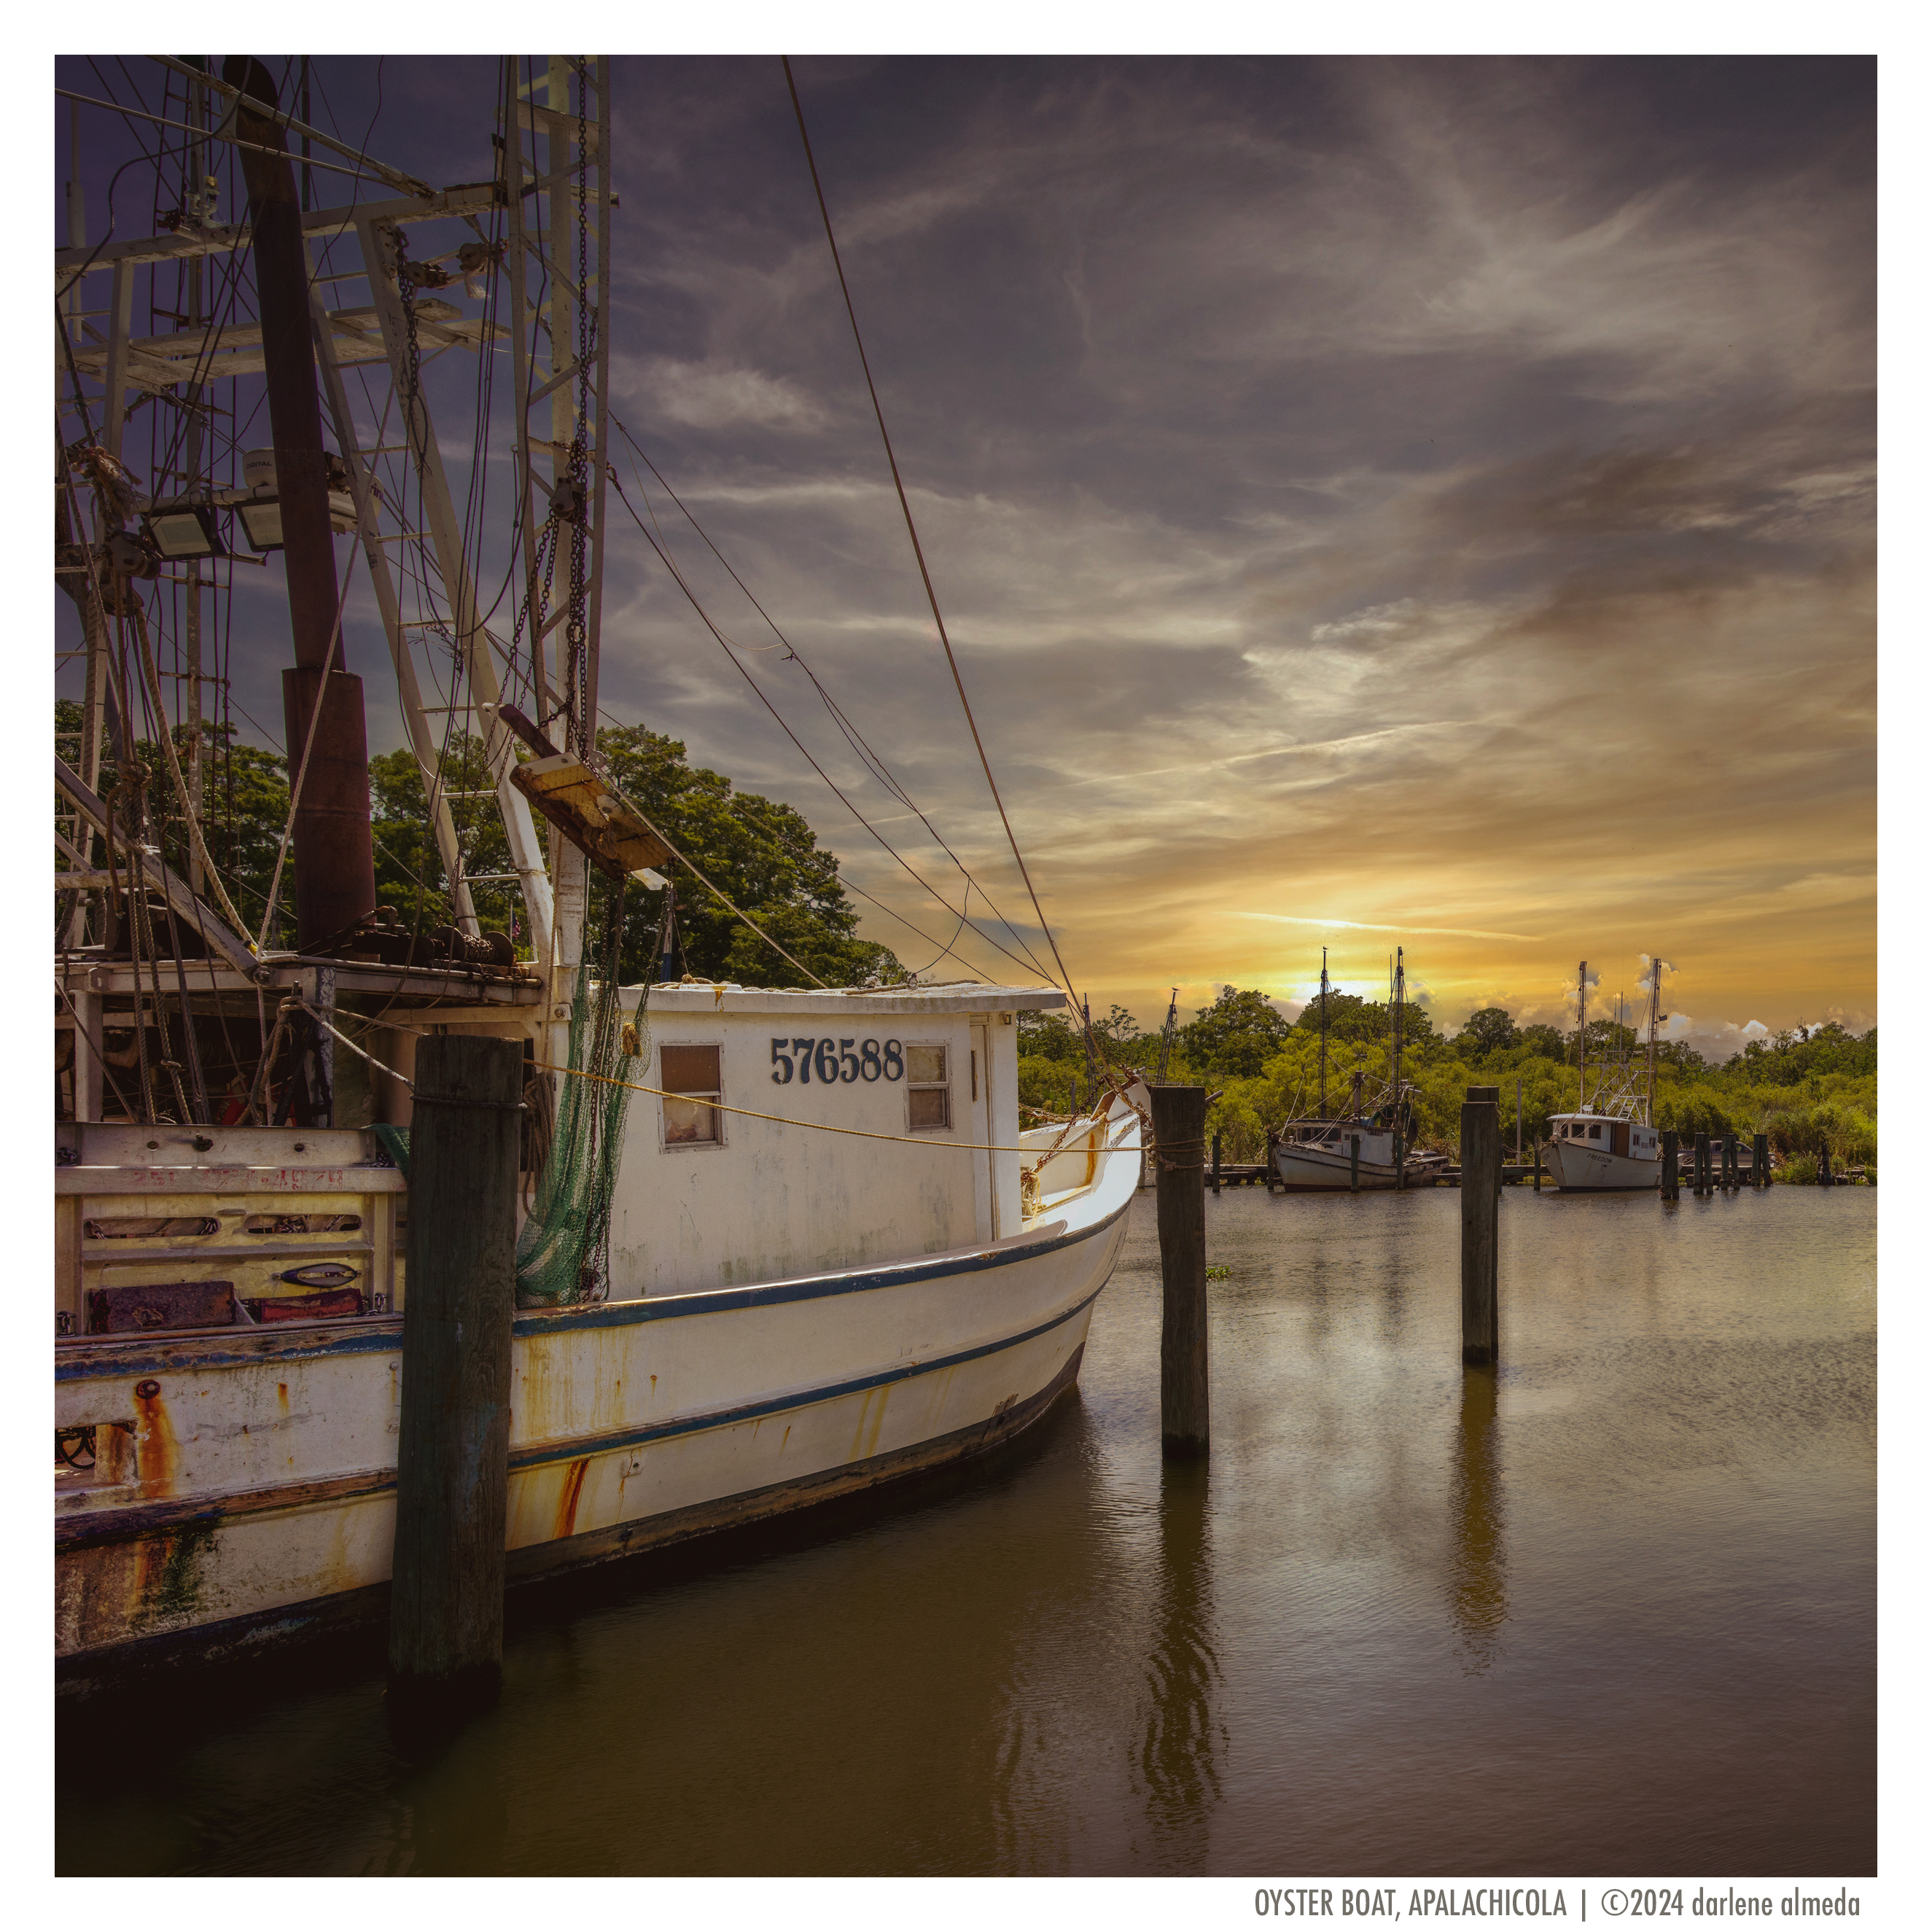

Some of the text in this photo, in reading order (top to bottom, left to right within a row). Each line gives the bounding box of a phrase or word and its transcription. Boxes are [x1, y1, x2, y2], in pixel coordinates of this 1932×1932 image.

[771, 1037, 904, 1085] 576588
[1587, 1153, 1613, 1164] FREEDOM
[133, 1171, 175, 1186] 251
